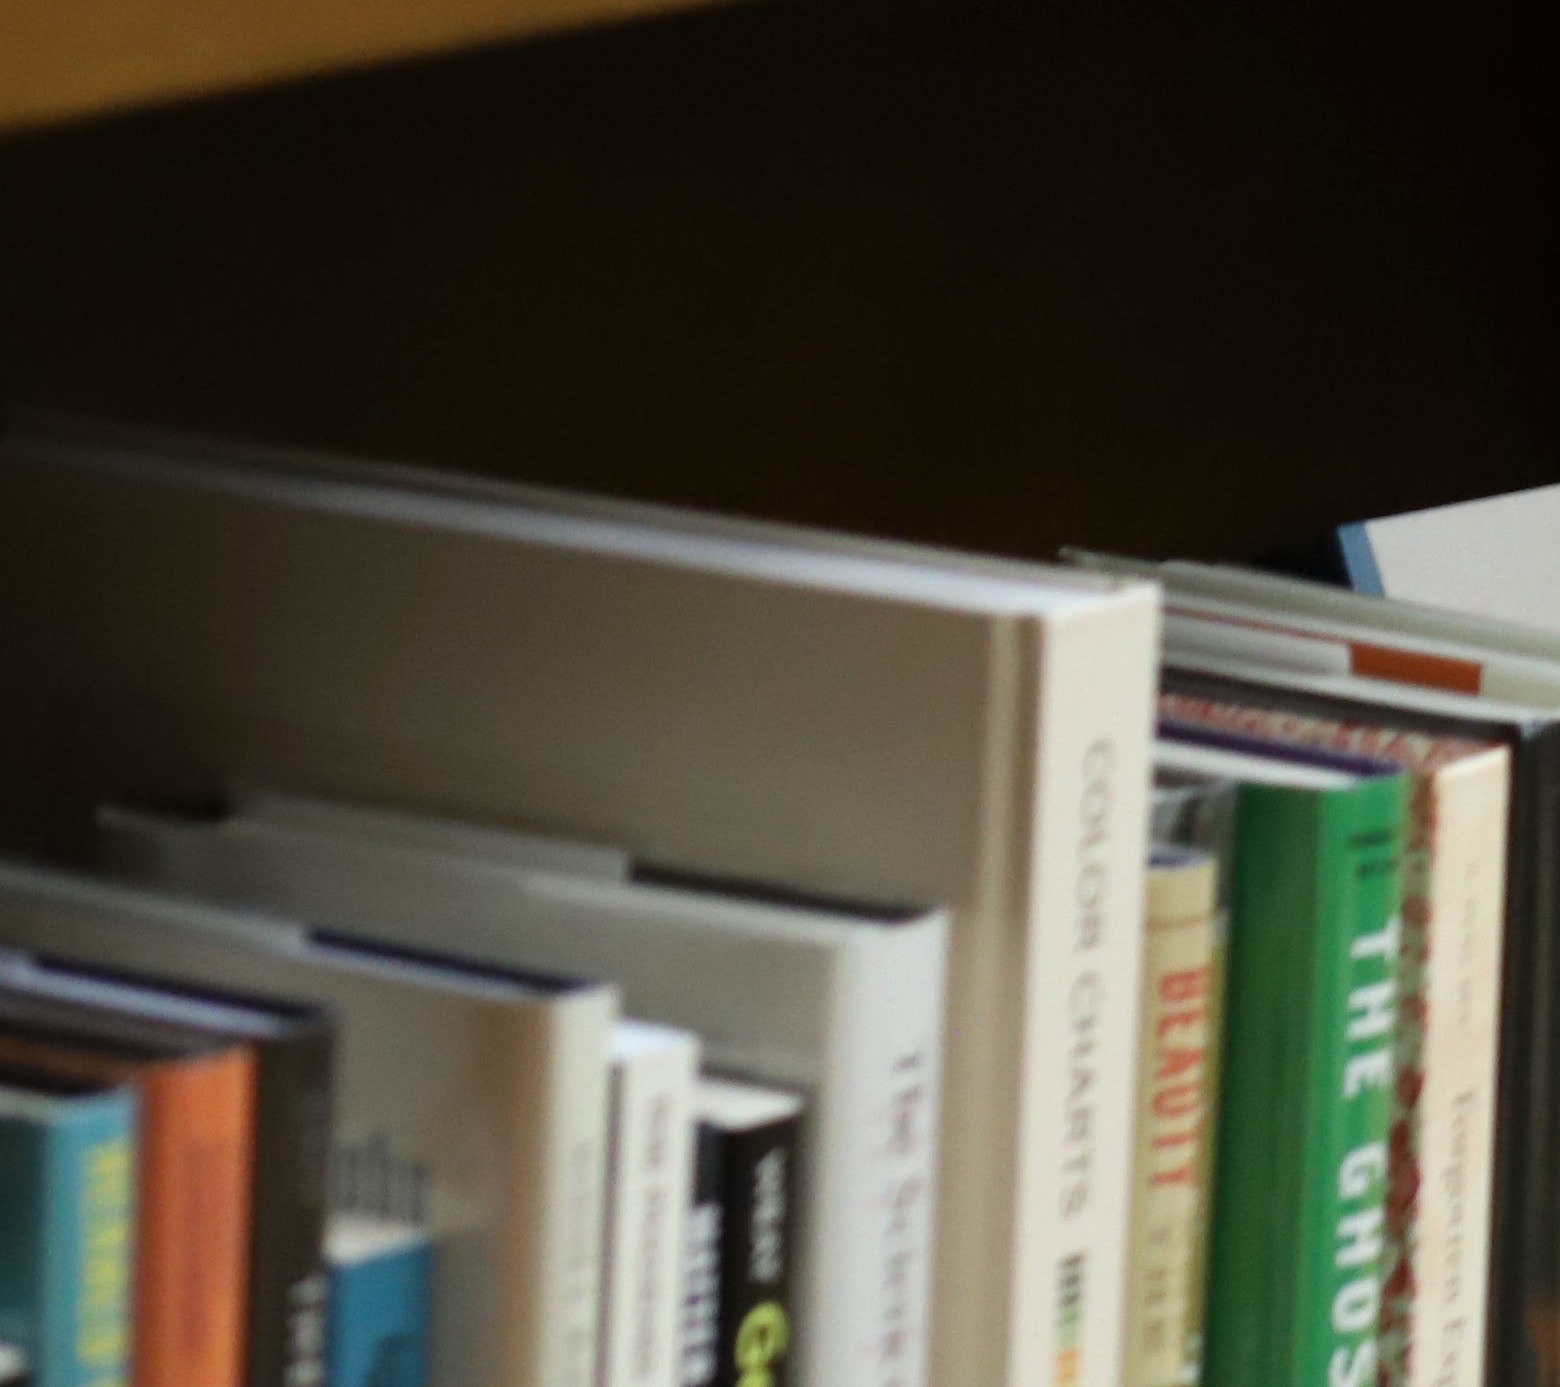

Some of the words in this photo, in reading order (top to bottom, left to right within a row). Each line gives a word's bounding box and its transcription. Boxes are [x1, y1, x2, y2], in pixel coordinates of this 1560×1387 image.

[1074, 736, 1118, 960] COLOR
[1059, 969, 1106, 1218] CHARTS
[1146, 963, 1211, 1192] BEAUTY
[1343, 914, 1399, 1099] THE
